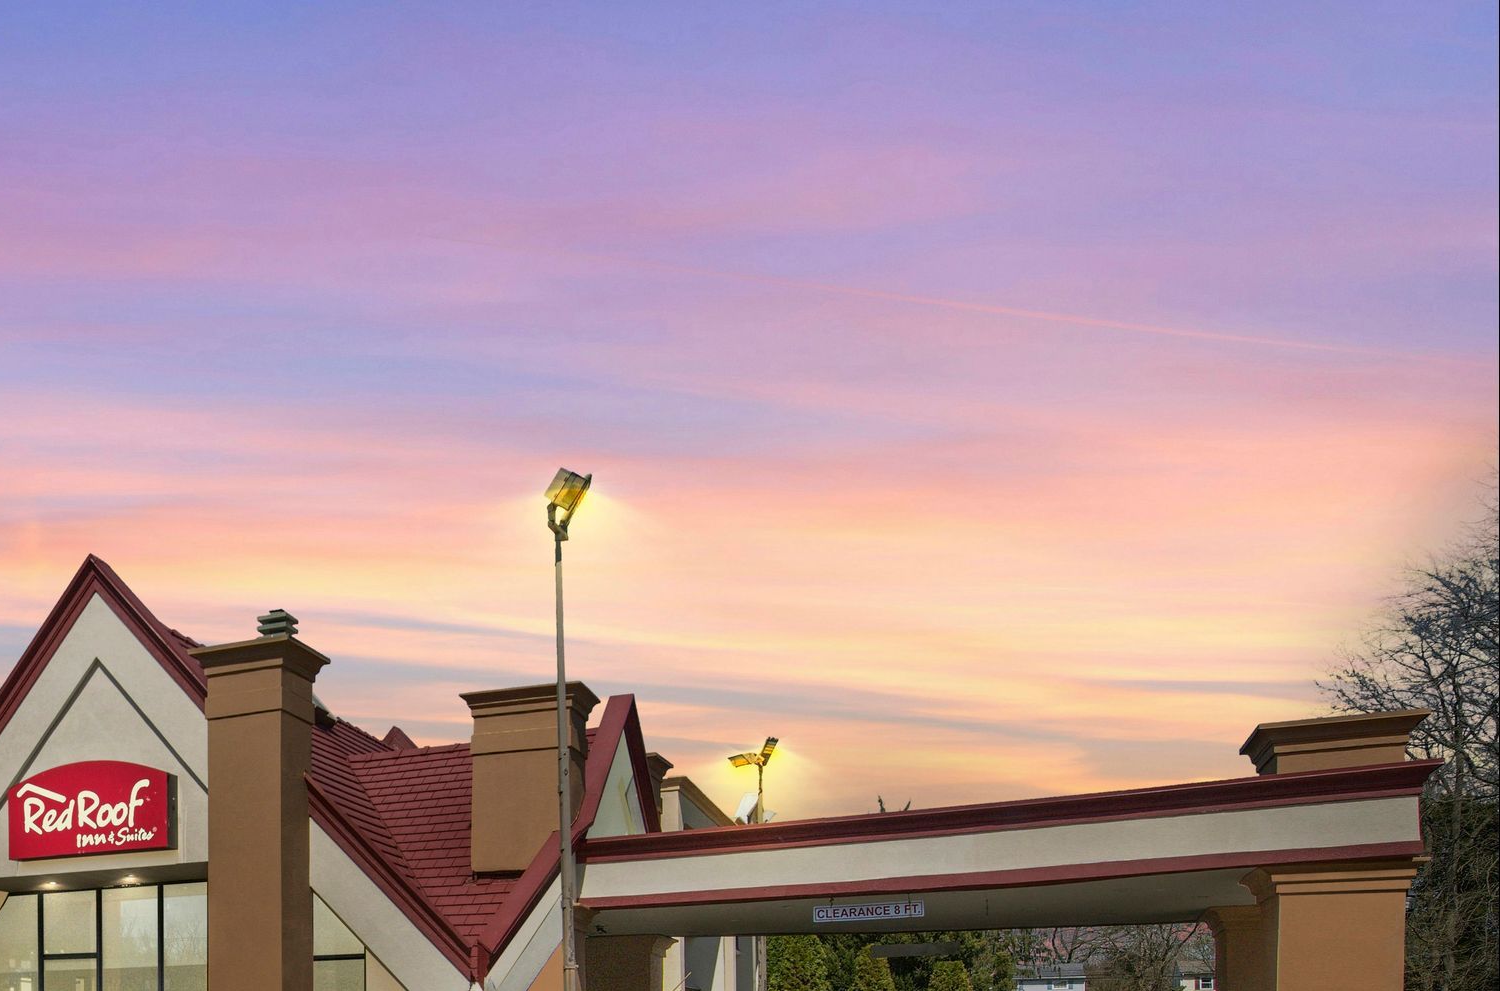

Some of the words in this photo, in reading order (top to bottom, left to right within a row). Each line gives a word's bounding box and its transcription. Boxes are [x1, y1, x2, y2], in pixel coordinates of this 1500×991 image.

[23, 796, 76, 836] Red
[76, 778, 150, 830] Roof
[107, 831, 115, 845] &
[816, 905, 891, 919] CLEARANCE
[894, 904, 901, 915] 8
